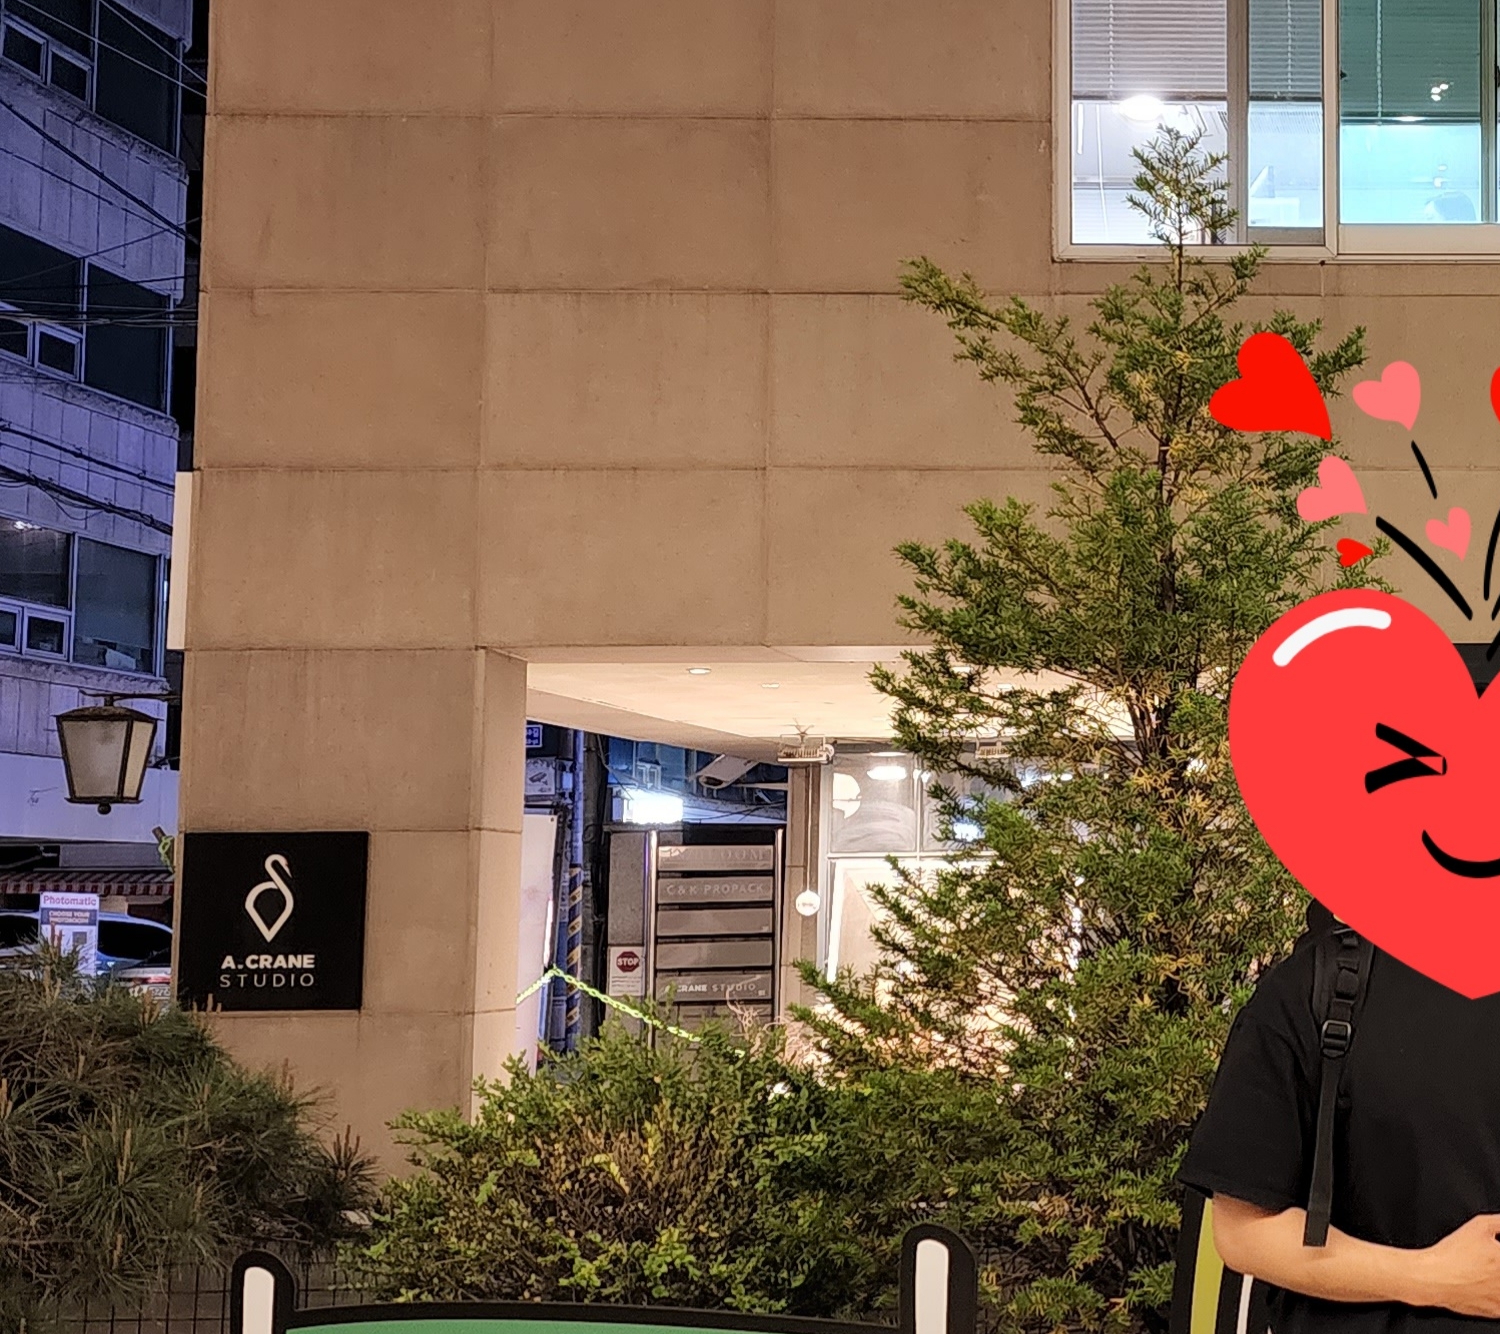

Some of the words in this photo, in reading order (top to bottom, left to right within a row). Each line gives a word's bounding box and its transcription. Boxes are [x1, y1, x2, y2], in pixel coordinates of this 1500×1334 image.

[703, 882, 763, 895] PROPACK
[43, 895, 97, 906] Photomatic
[221, 954, 316, 970] A.CRANE
[617, 957, 639, 966] STOP
[219, 973, 315, 988] STUDIO
